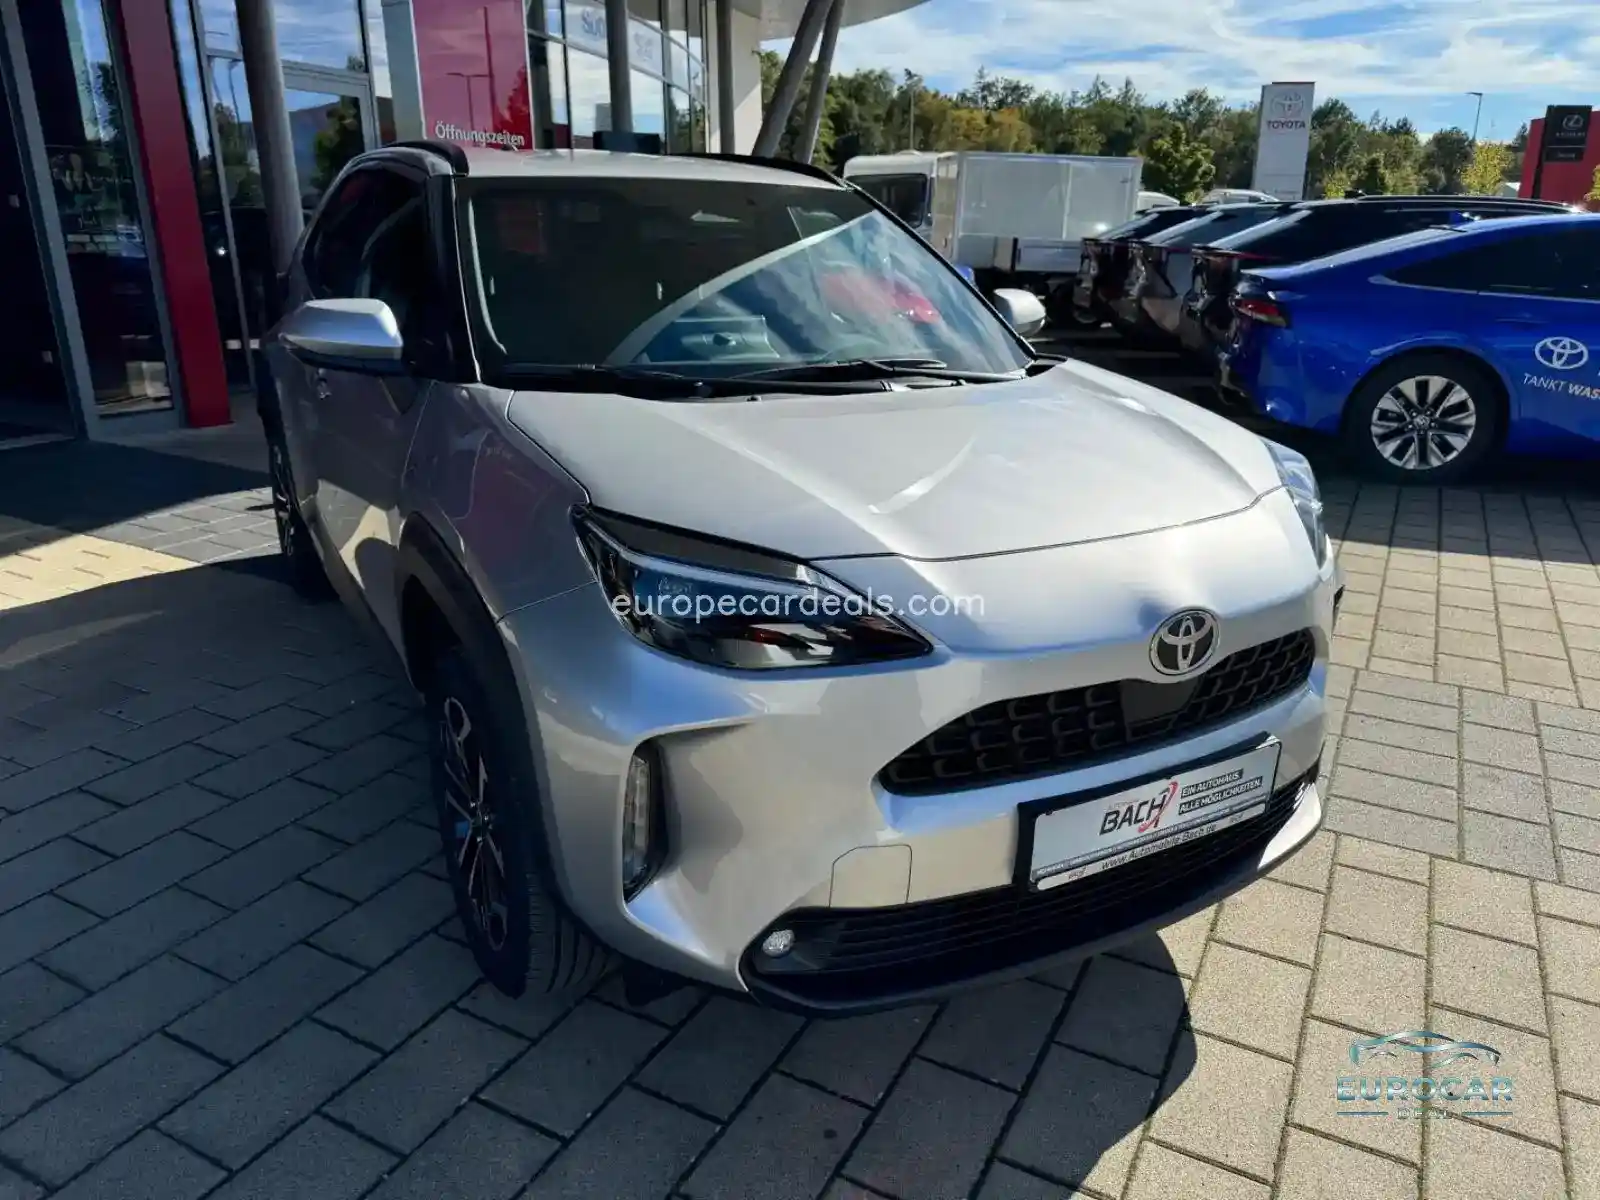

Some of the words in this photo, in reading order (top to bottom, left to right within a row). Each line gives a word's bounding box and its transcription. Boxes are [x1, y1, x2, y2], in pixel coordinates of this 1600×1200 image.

[435, 121, 525, 147] Öffnungszeiten
[1267, 120, 1306, 130] TOYOTA
[1523, 372, 1567, 392] TANKT
[1568, 383, 1600, 400] WAS
[1099, 793, 1168, 836] BACH
[1180, 799, 1201, 813] ALLE
